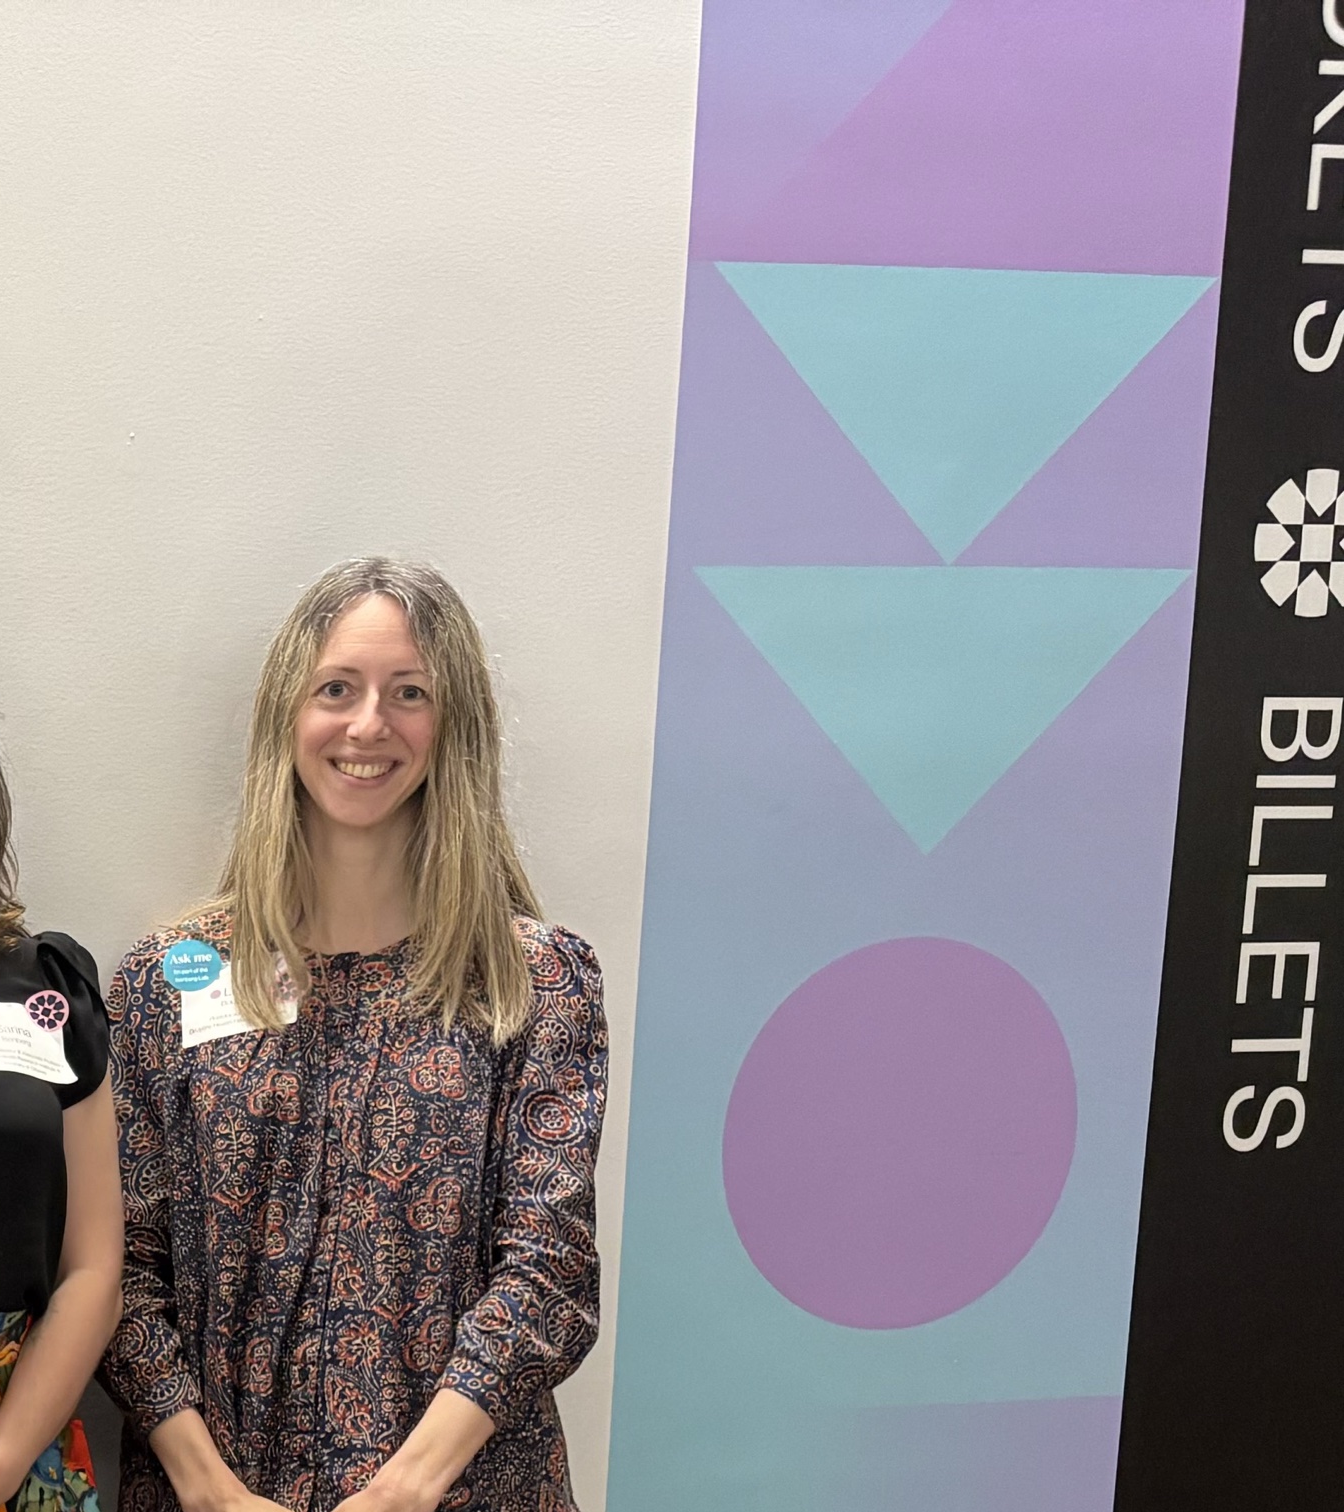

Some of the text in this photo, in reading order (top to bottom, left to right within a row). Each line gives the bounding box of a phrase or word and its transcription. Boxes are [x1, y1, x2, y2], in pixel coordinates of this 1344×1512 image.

[170, 953, 213, 965] Ask me
[1222, 696, 1344, 1152] BILLETS
